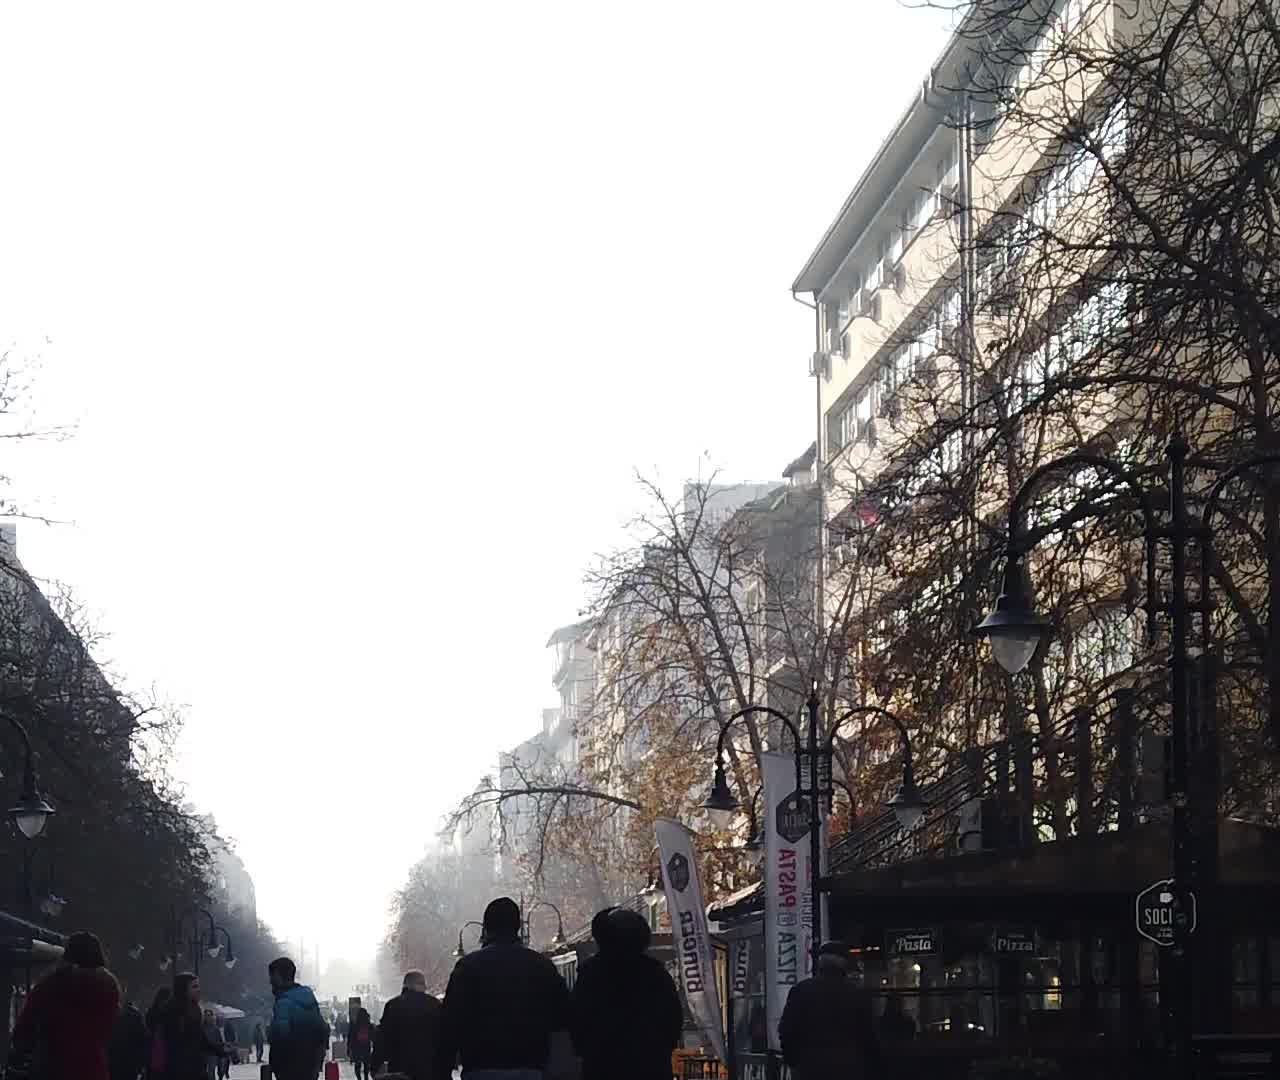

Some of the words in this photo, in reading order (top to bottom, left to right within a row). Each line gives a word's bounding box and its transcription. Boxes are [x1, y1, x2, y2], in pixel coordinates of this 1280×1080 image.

[1144, 907, 1173, 925] SOCI
[896, 936, 933, 953] Pasta
[997, 938, 1033, 952] Pizza
